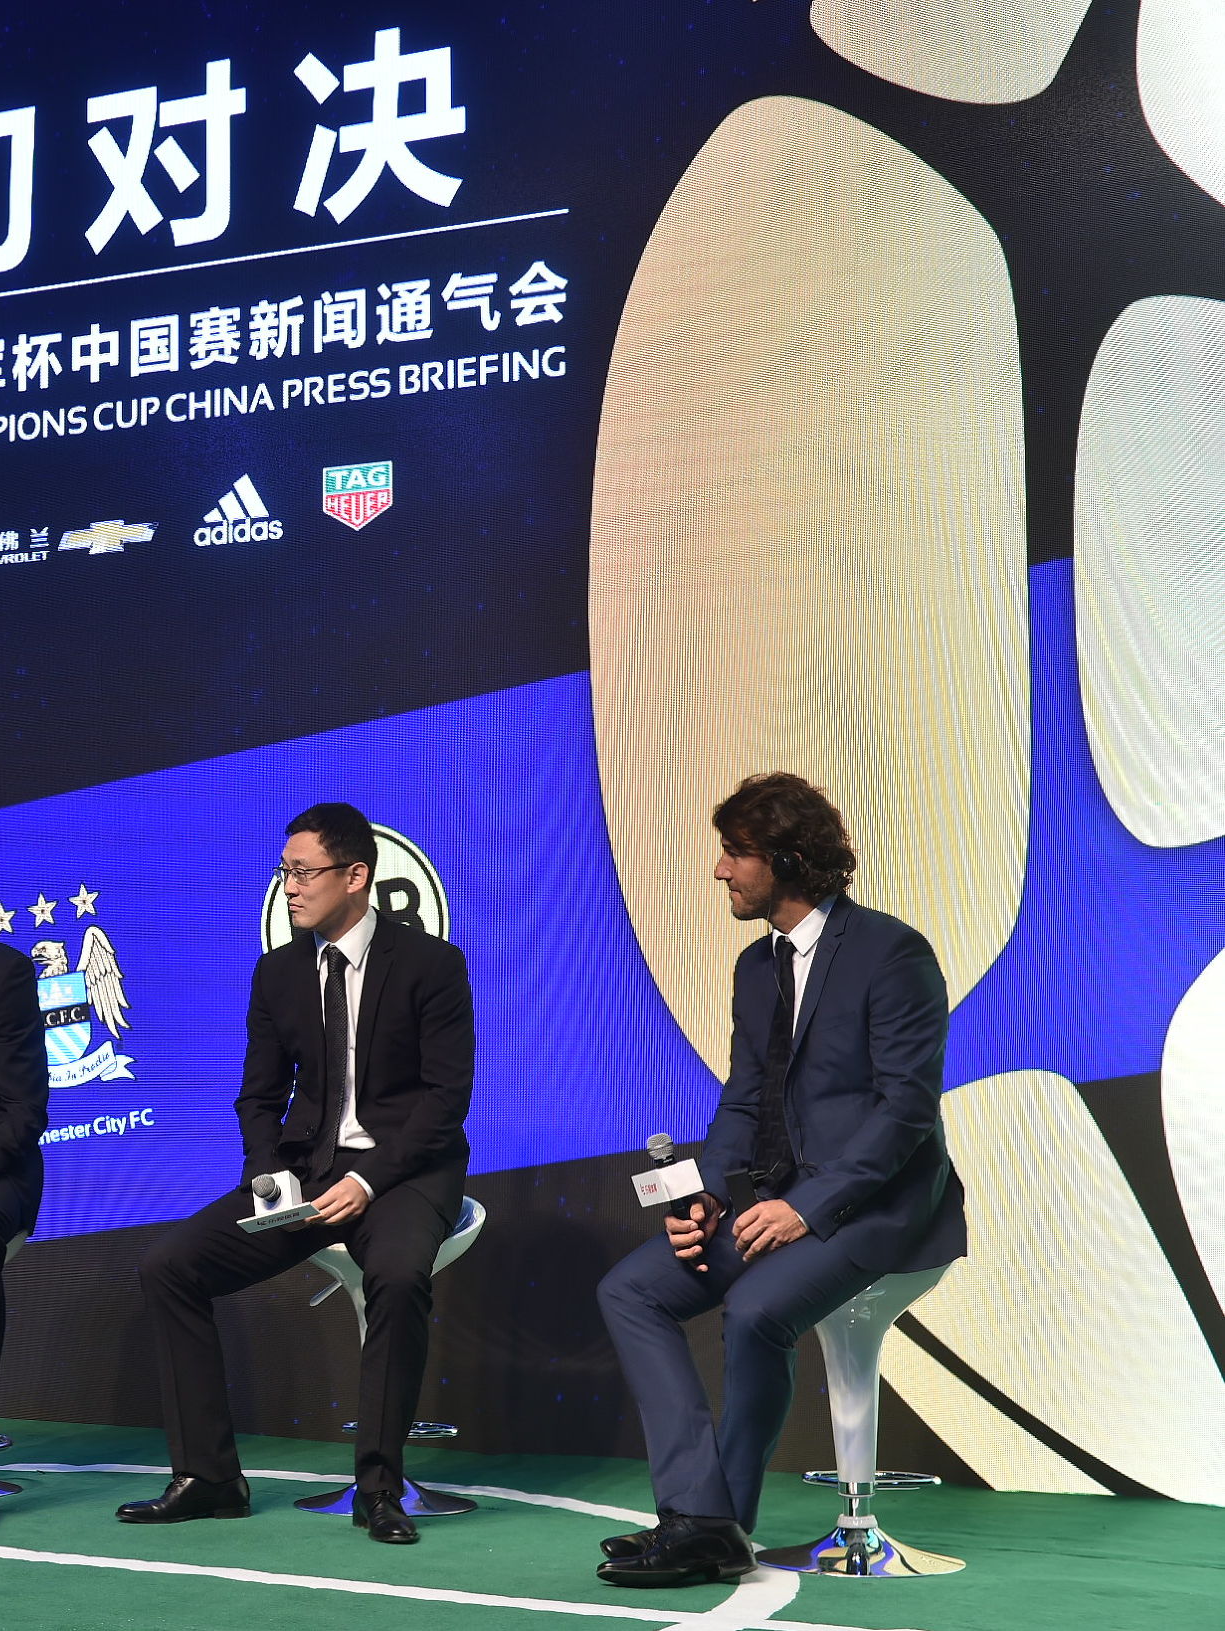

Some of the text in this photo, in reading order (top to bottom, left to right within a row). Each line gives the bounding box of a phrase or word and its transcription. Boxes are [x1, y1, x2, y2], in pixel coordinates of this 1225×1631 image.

[92, 395, 162, 428] CUP
[167, 381, 276, 423] CHINA
[282, 367, 392, 410] PRESS
[398, 345, 567, 396] BRIEFING
[329, 466, 387, 491] TAG
[326, 490, 389, 526] HEUER
[193, 517, 284, 547] adidas
[92, 1115, 127, 1136] City
[129, 1107, 155, 1130] FC
